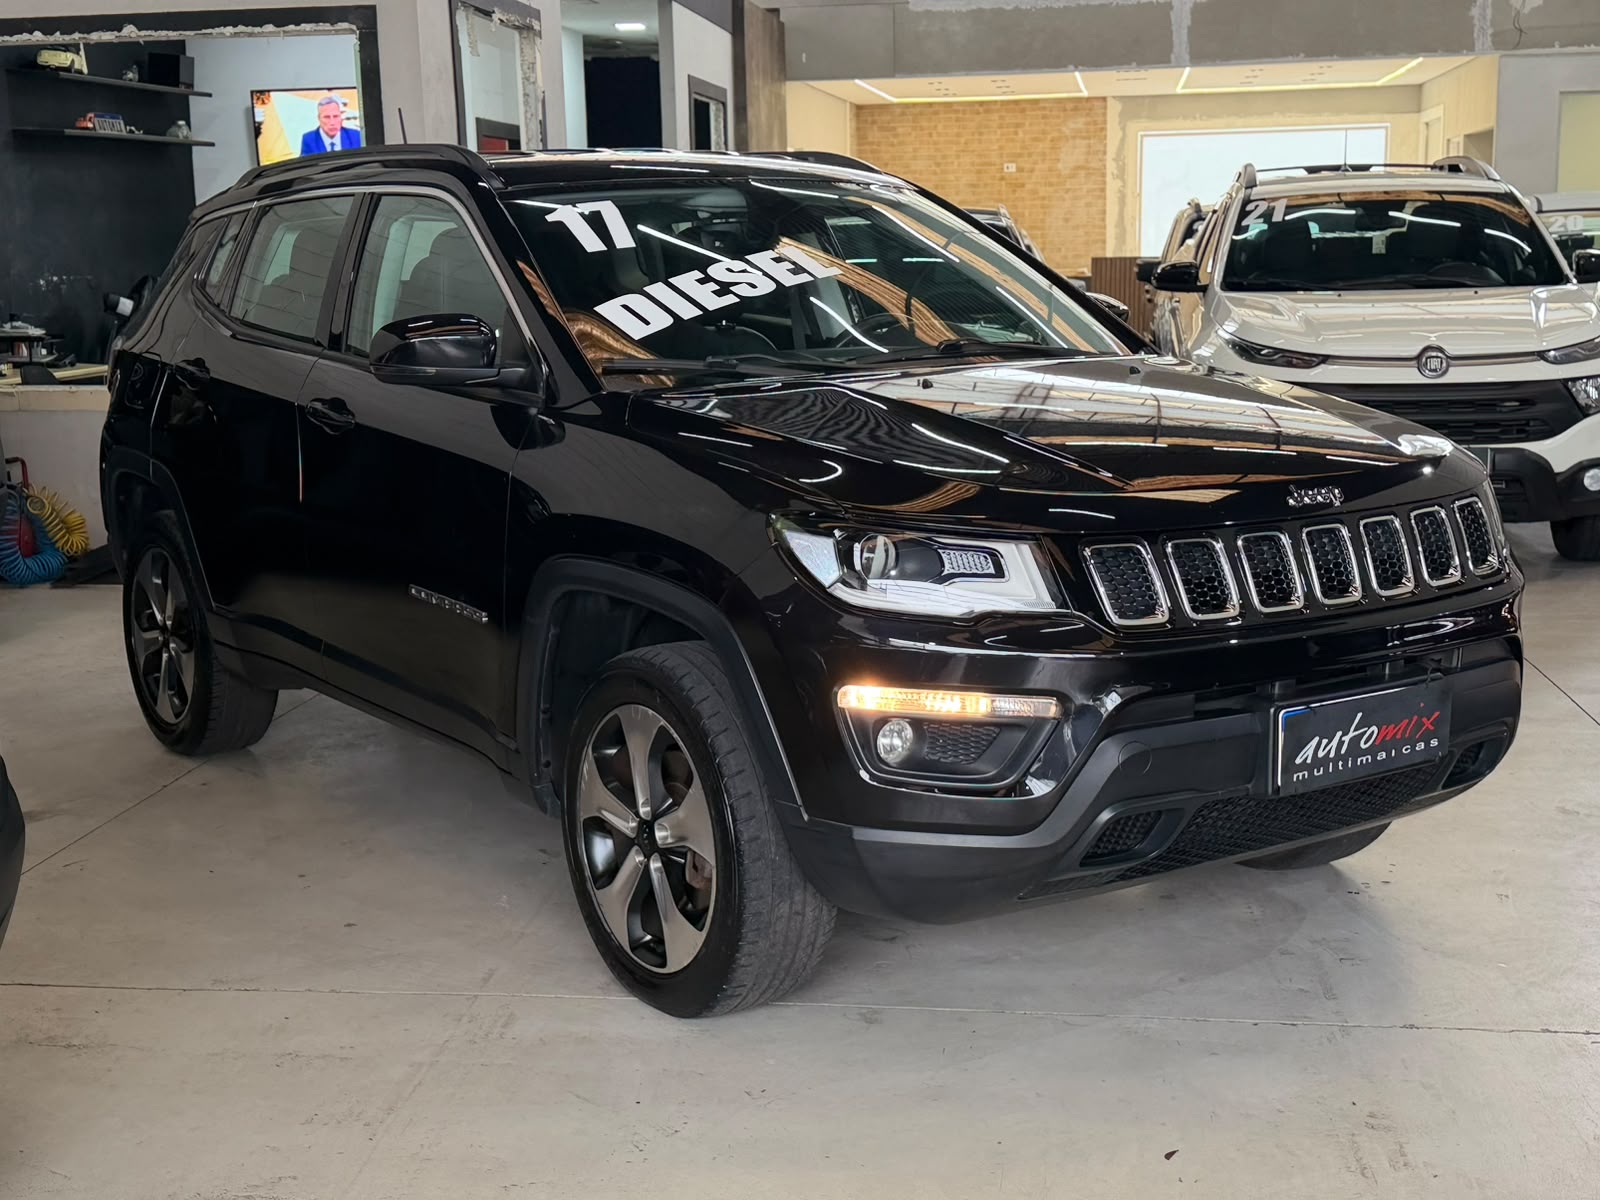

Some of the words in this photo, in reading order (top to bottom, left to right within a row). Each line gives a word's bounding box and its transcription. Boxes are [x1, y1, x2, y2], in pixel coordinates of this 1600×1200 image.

[545, 200, 636, 252] 17
[1243, 199, 1287, 226] 21
[1548, 215, 1584, 233] 20
[593, 246, 842, 340] DIESEL
[1286, 485, 1344, 508] Jeep
[1294, 702, 1440, 765] automix
